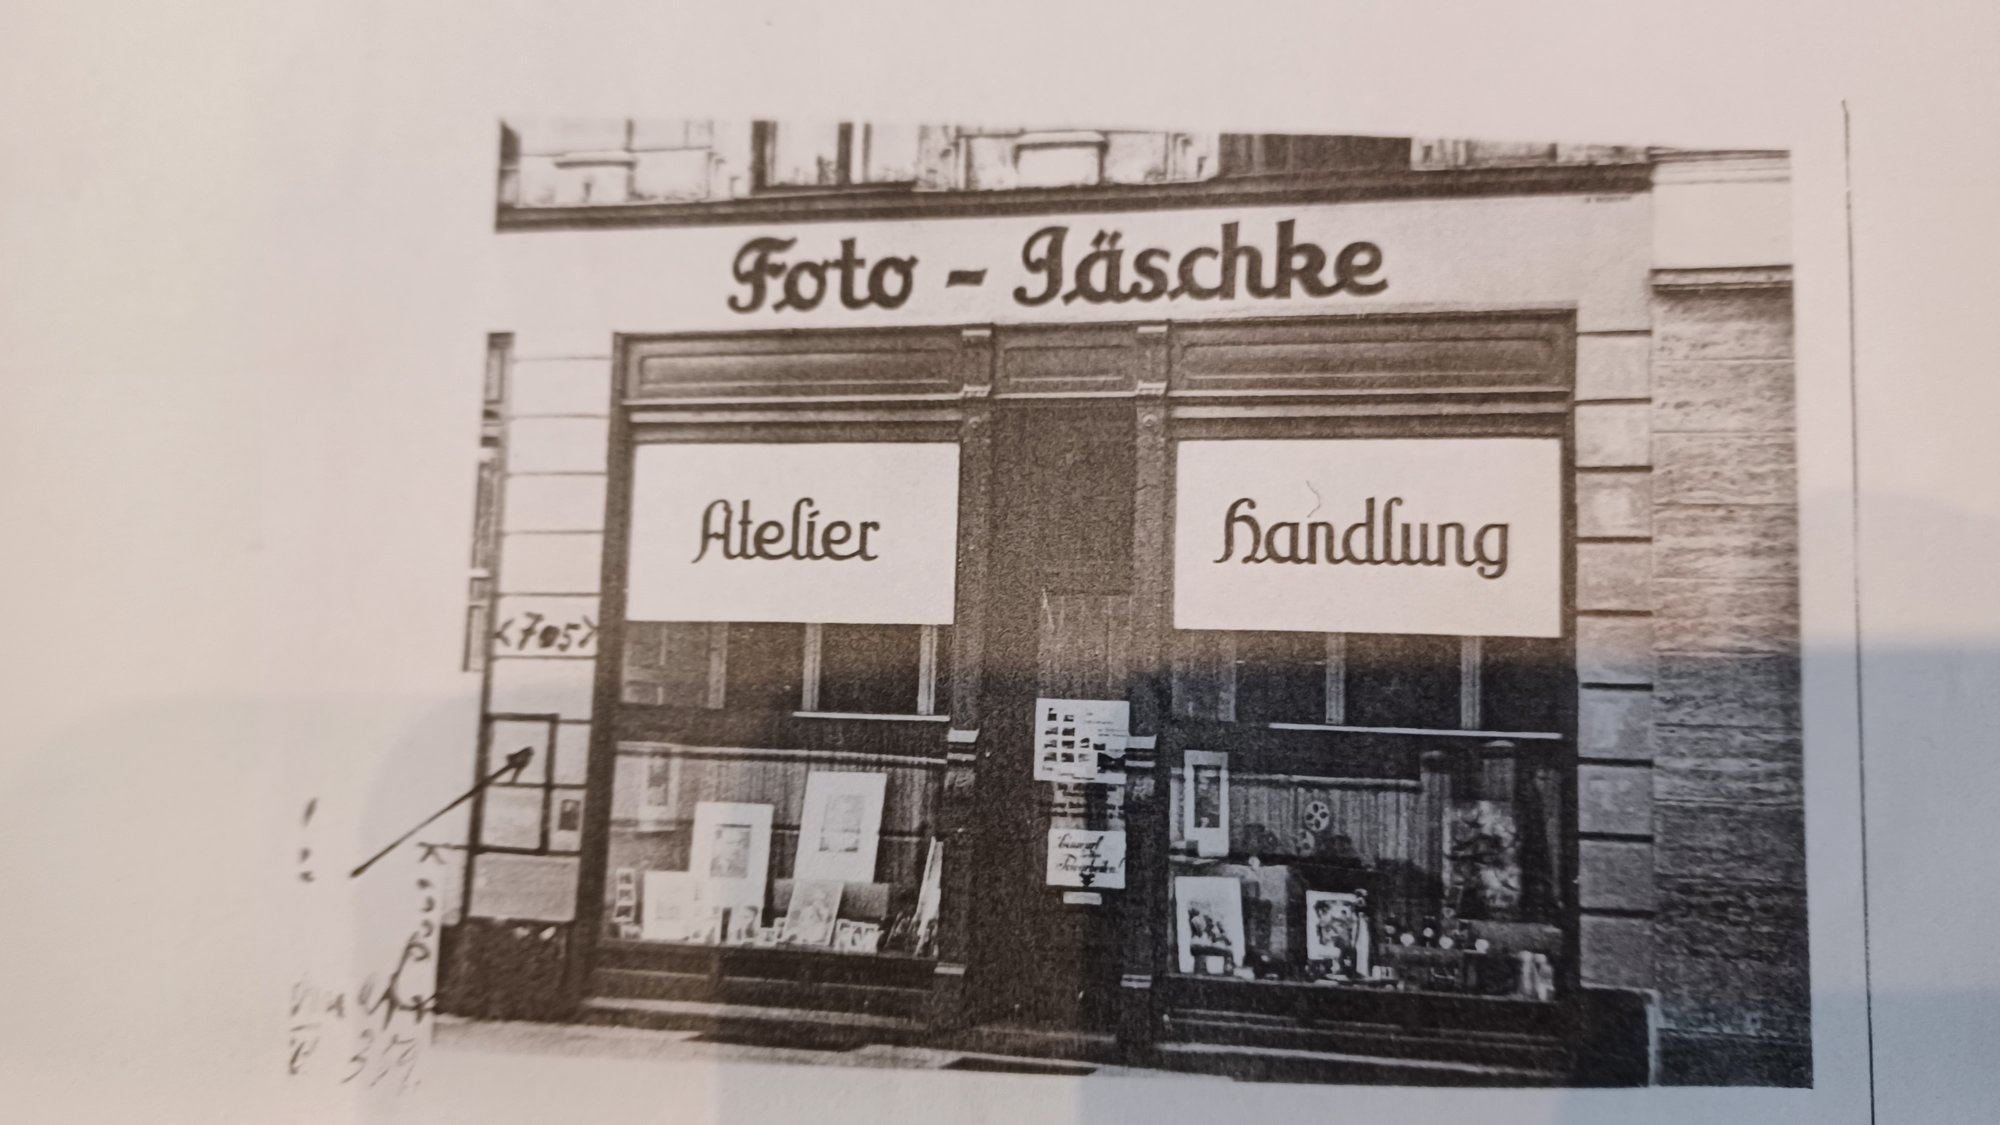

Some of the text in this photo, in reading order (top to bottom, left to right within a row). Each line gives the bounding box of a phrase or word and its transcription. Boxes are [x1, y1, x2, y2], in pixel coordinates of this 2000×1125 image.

[728, 236, 919, 313] Foto
[1013, 218, 1389, 307] Jäschke
[691, 497, 880, 564] Atelier
[1213, 497, 1510, 580] Handlung
